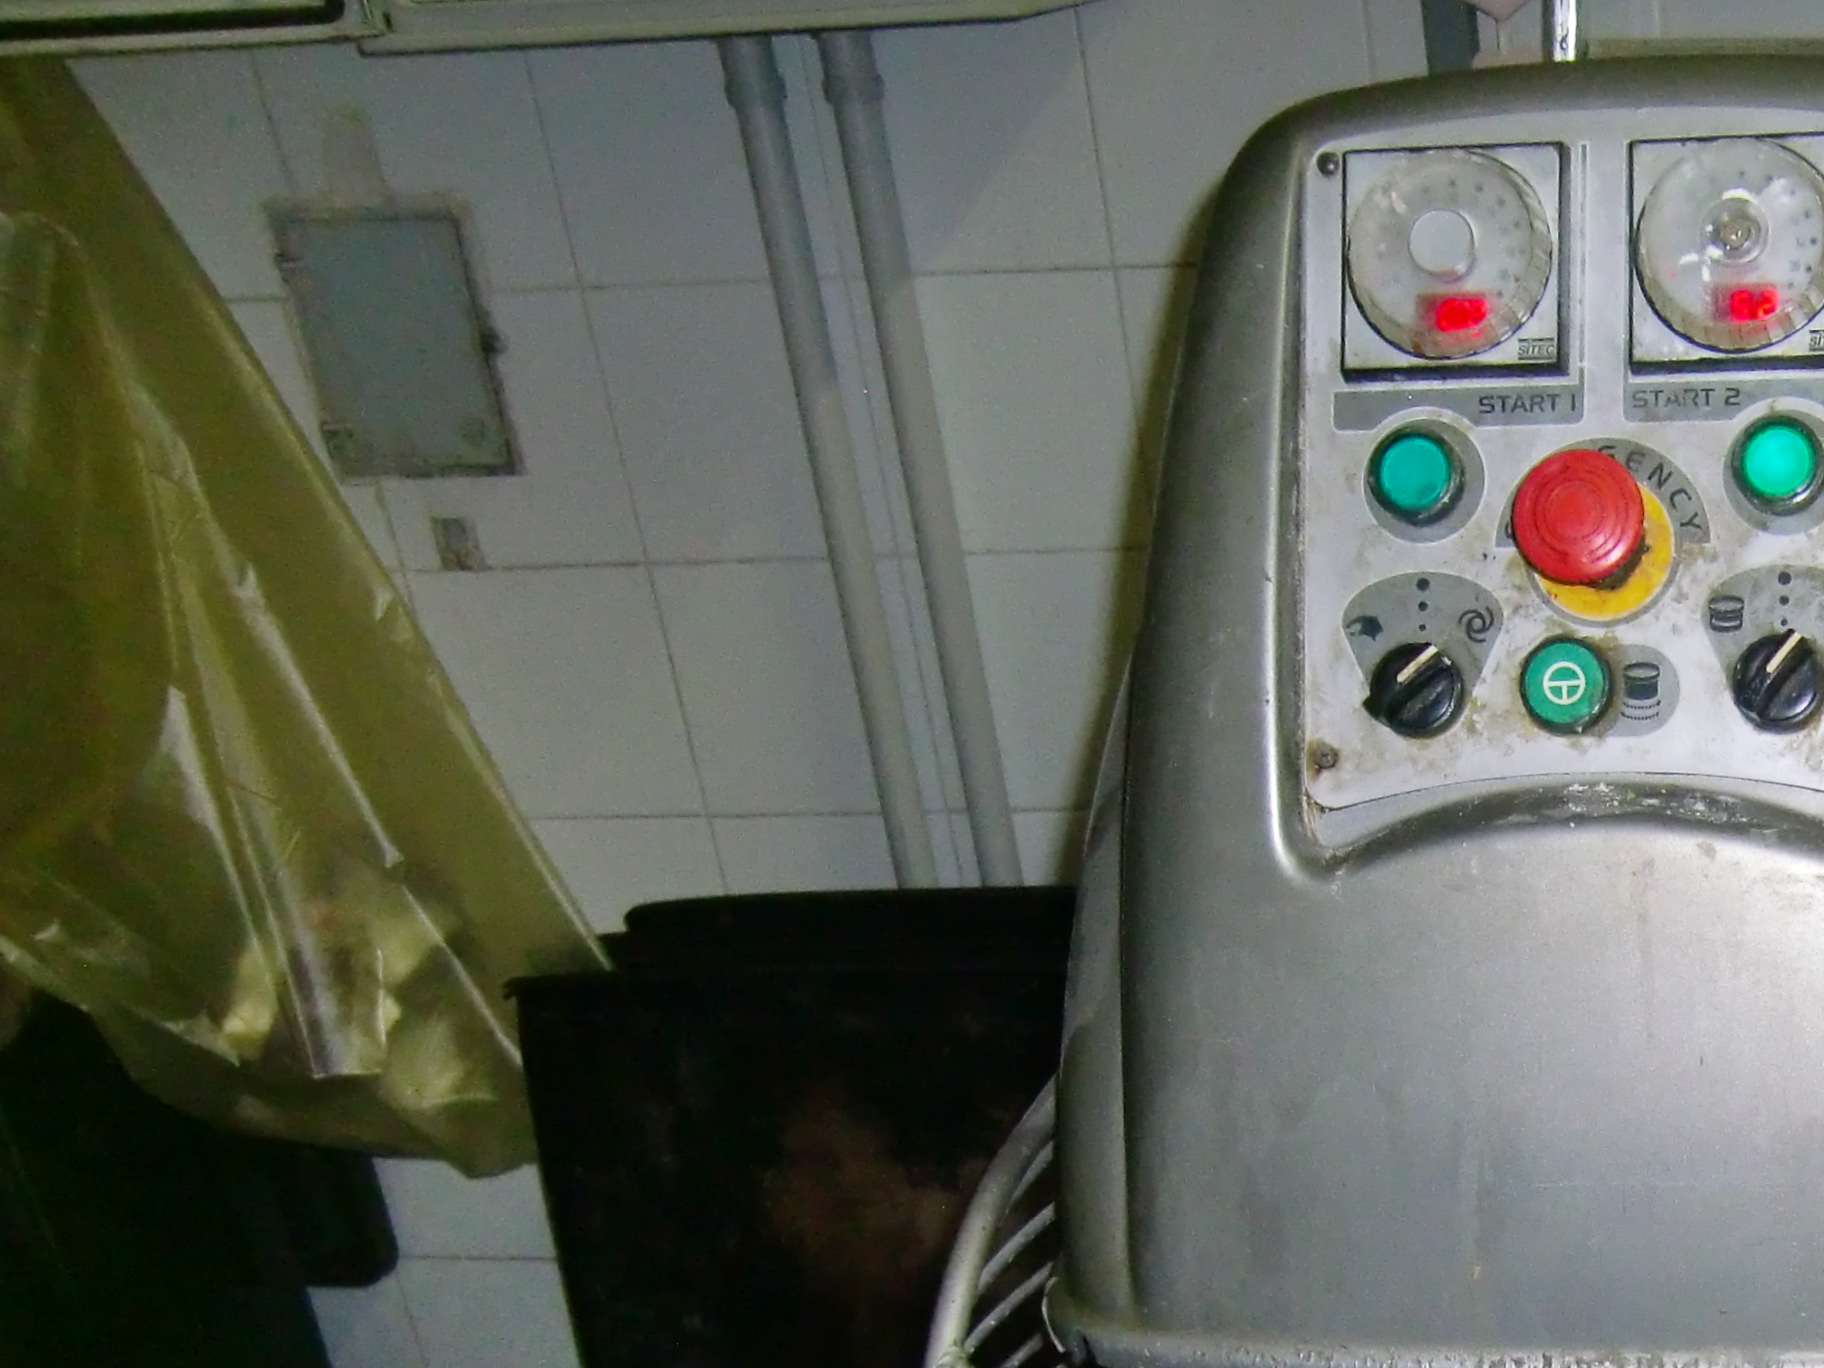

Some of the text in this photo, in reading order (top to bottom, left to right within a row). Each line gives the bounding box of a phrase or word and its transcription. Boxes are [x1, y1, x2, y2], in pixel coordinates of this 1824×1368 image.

[1479, 394, 1560, 414] START
[1632, 387, 1740, 409] START 2
